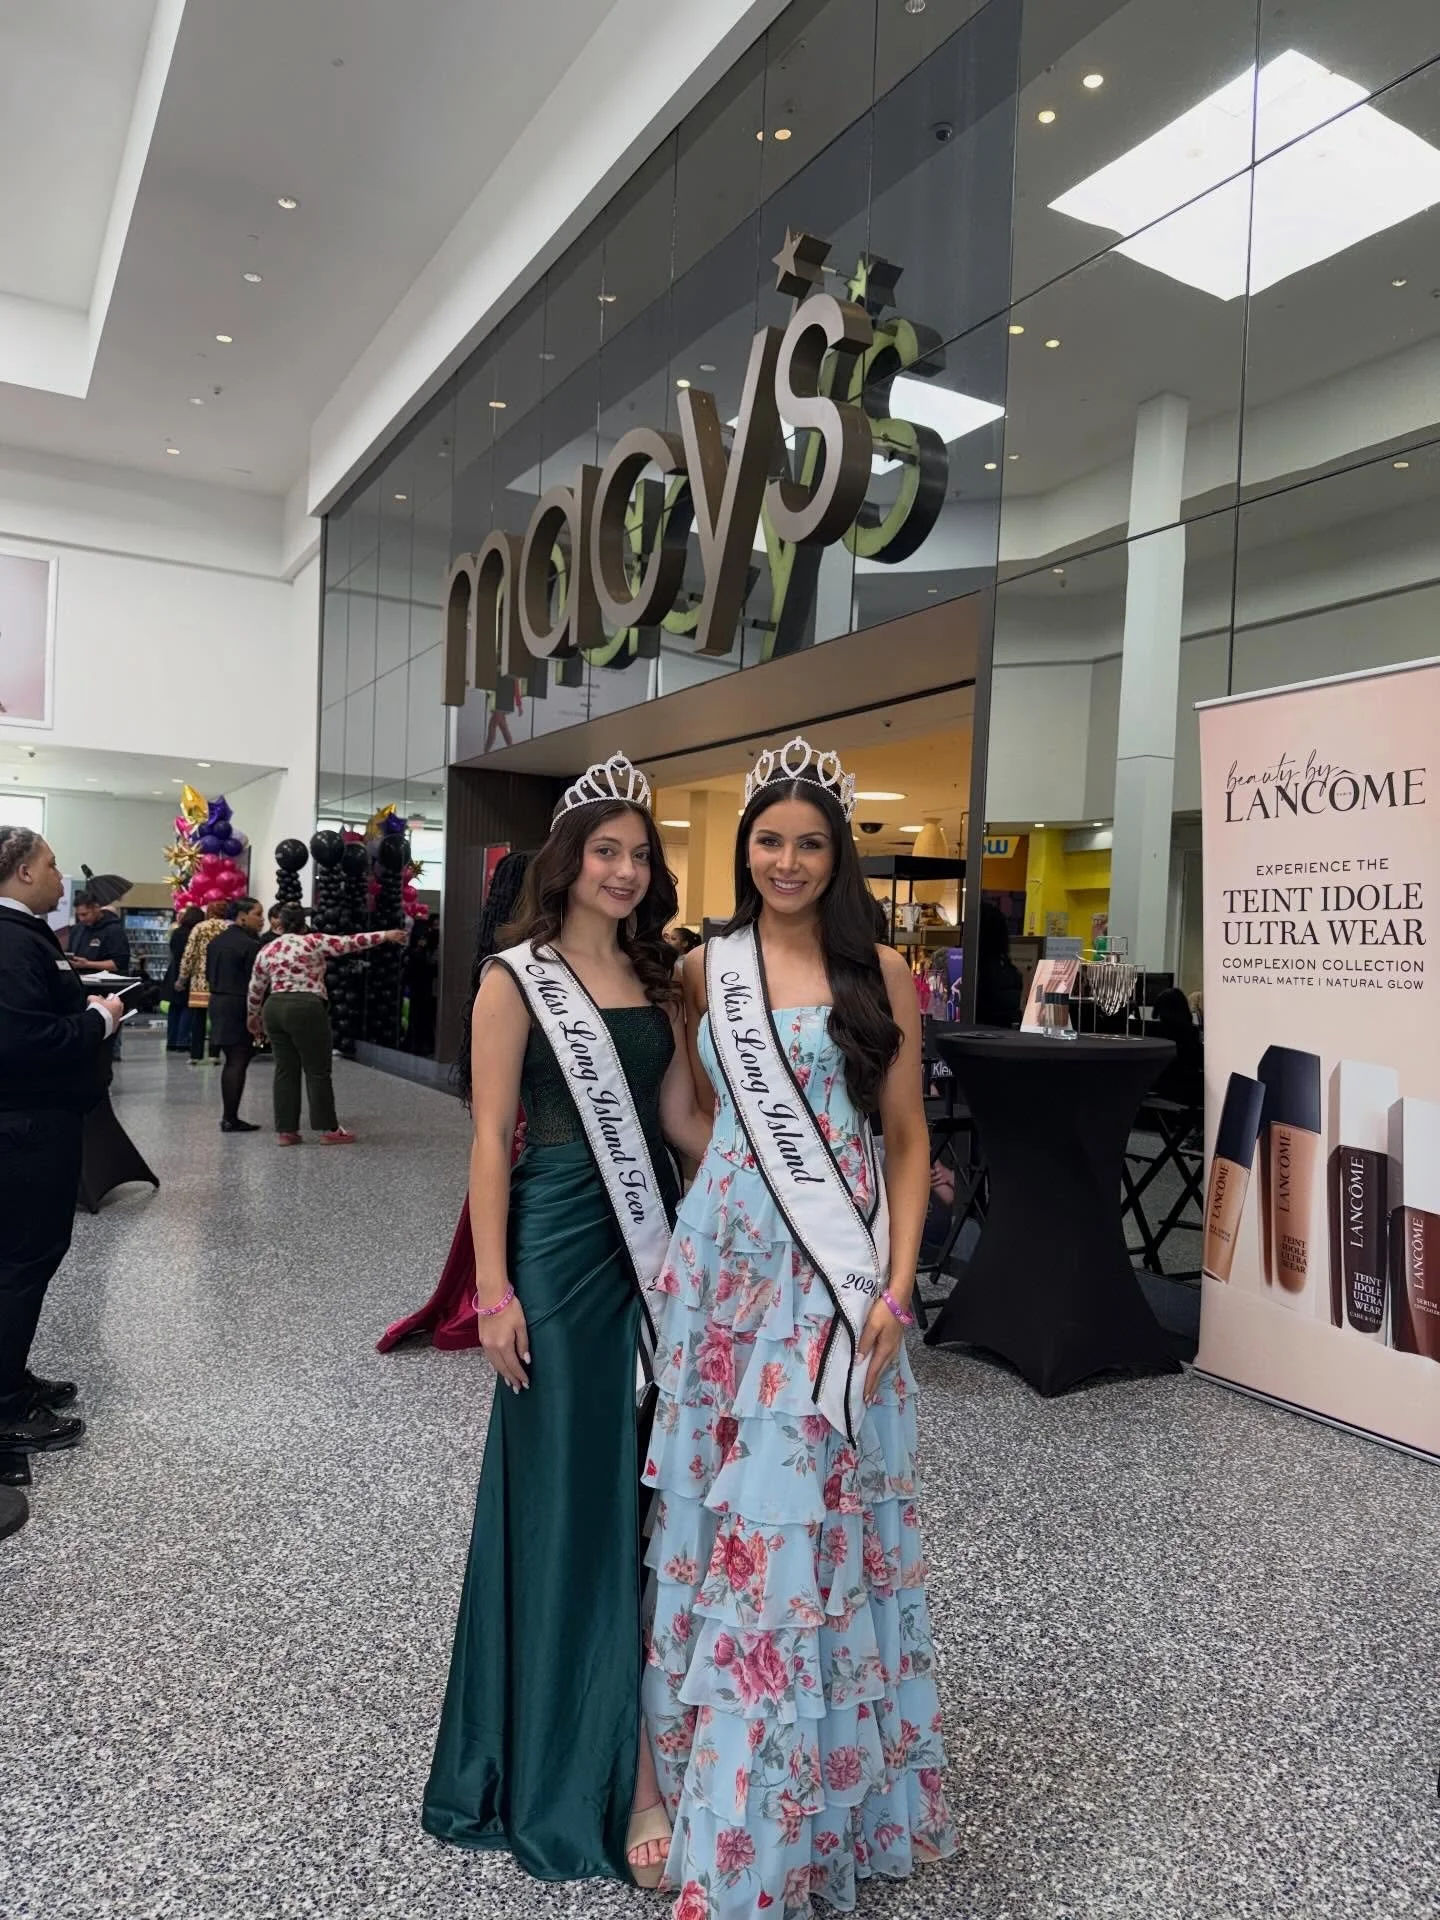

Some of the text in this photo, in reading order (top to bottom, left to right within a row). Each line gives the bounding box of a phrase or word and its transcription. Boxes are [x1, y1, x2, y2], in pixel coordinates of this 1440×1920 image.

[1226, 749, 1339, 801] beauty by
[1225, 767, 1426, 822] LANCÔME
[1256, 858, 1389, 876] EXPERIENCE THE
[1223, 882, 1423, 913] TEINT IDOLE
[1222, 918, 1426, 946] ULTRA WEAR
[1222, 957, 1424, 972] COMPLEXION COLLECTION
[1222, 975, 1273, 985] NATURAL
[1276, 977, 1314, 986] MATTE
[1326, 978, 1383, 989] NATURAL
[1387, 979, 1424, 990] GLOW
[720, 971, 825, 1184] Miss Long Island
[525, 964, 649, 1225] Miss Long Island Teen
[1348, 1156, 1364, 1249] LANCÔME
[1411, 1217, 1424, 1290] LANCÔME
[1354, 1272, 1382, 1287] TEINT
[1354, 1282, 1382, 1297] IDOLE
[1353, 1290, 1382, 1307] ULTRA
[1354, 1300, 1381, 1315] WEAR
